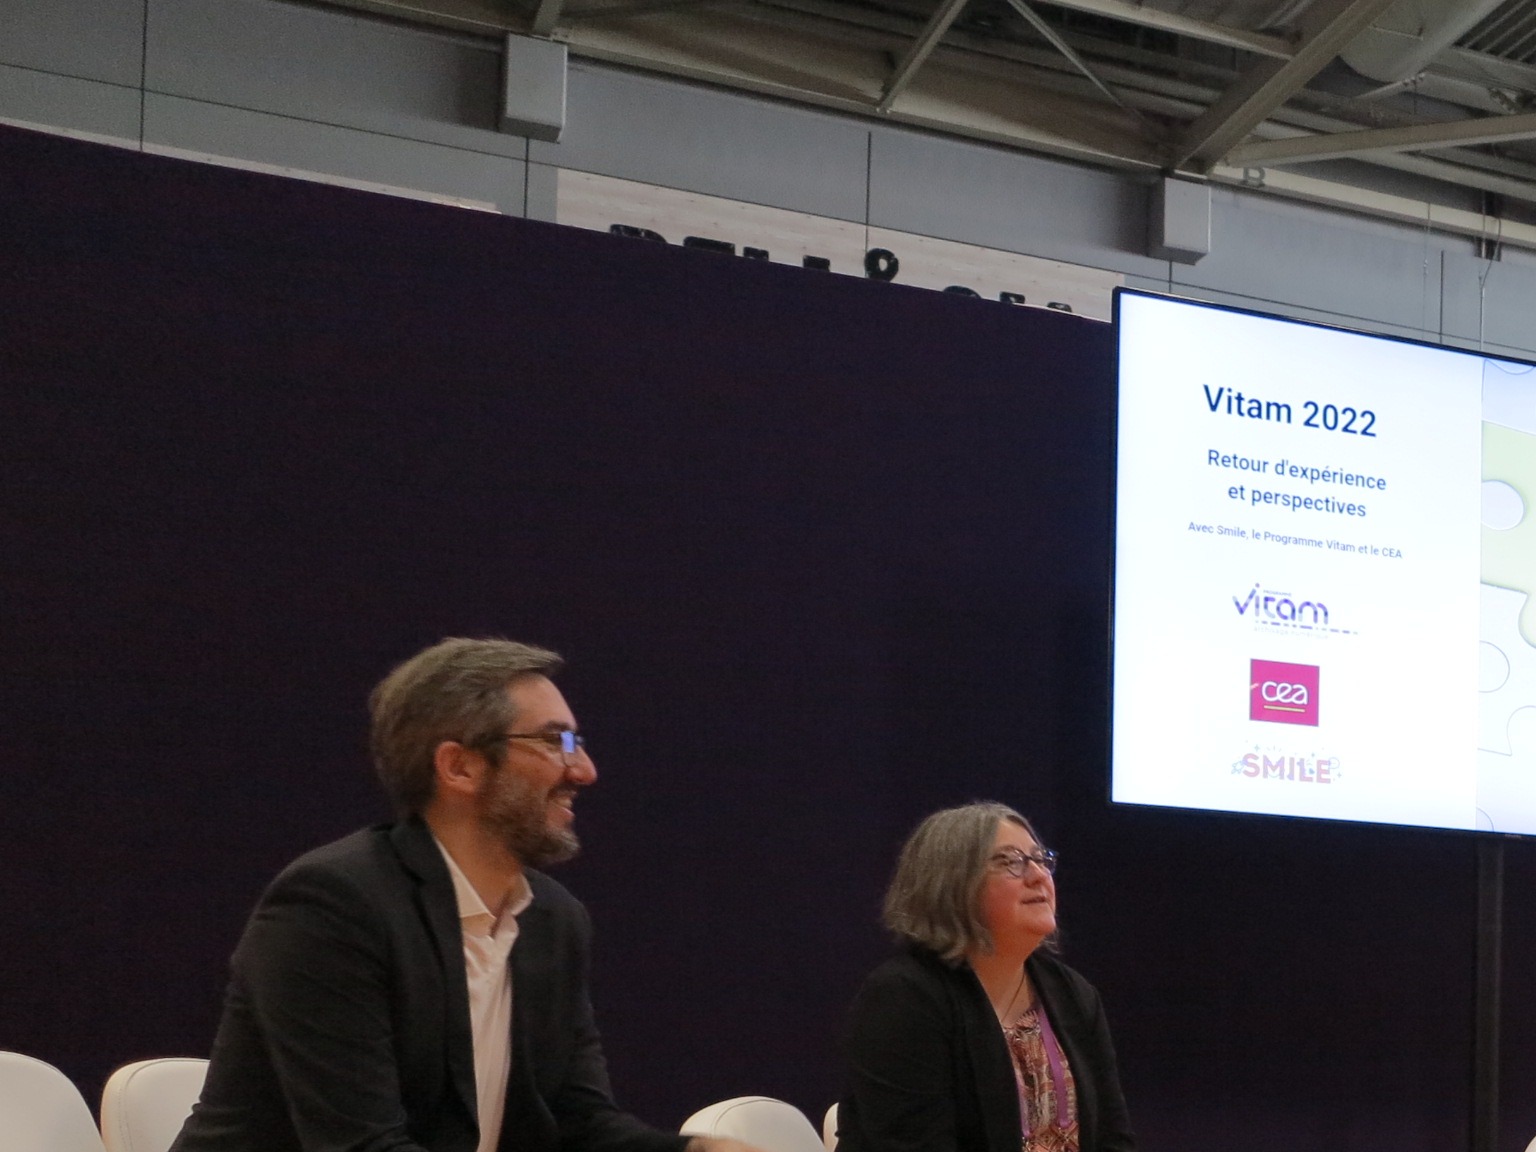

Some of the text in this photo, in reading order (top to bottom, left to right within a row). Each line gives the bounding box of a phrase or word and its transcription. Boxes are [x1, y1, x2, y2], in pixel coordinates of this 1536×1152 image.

[1203, 384, 1377, 437] Vitam 2022
[1207, 449, 1387, 490] Retour d'expérience
[1228, 485, 1366, 517] et perspectives
[1188, 522, 1403, 559] Avec Smile, le Programme Vitam et le CEA
[1261, 681, 1308, 705] cea
[1242, 753, 1331, 784] SMILE
